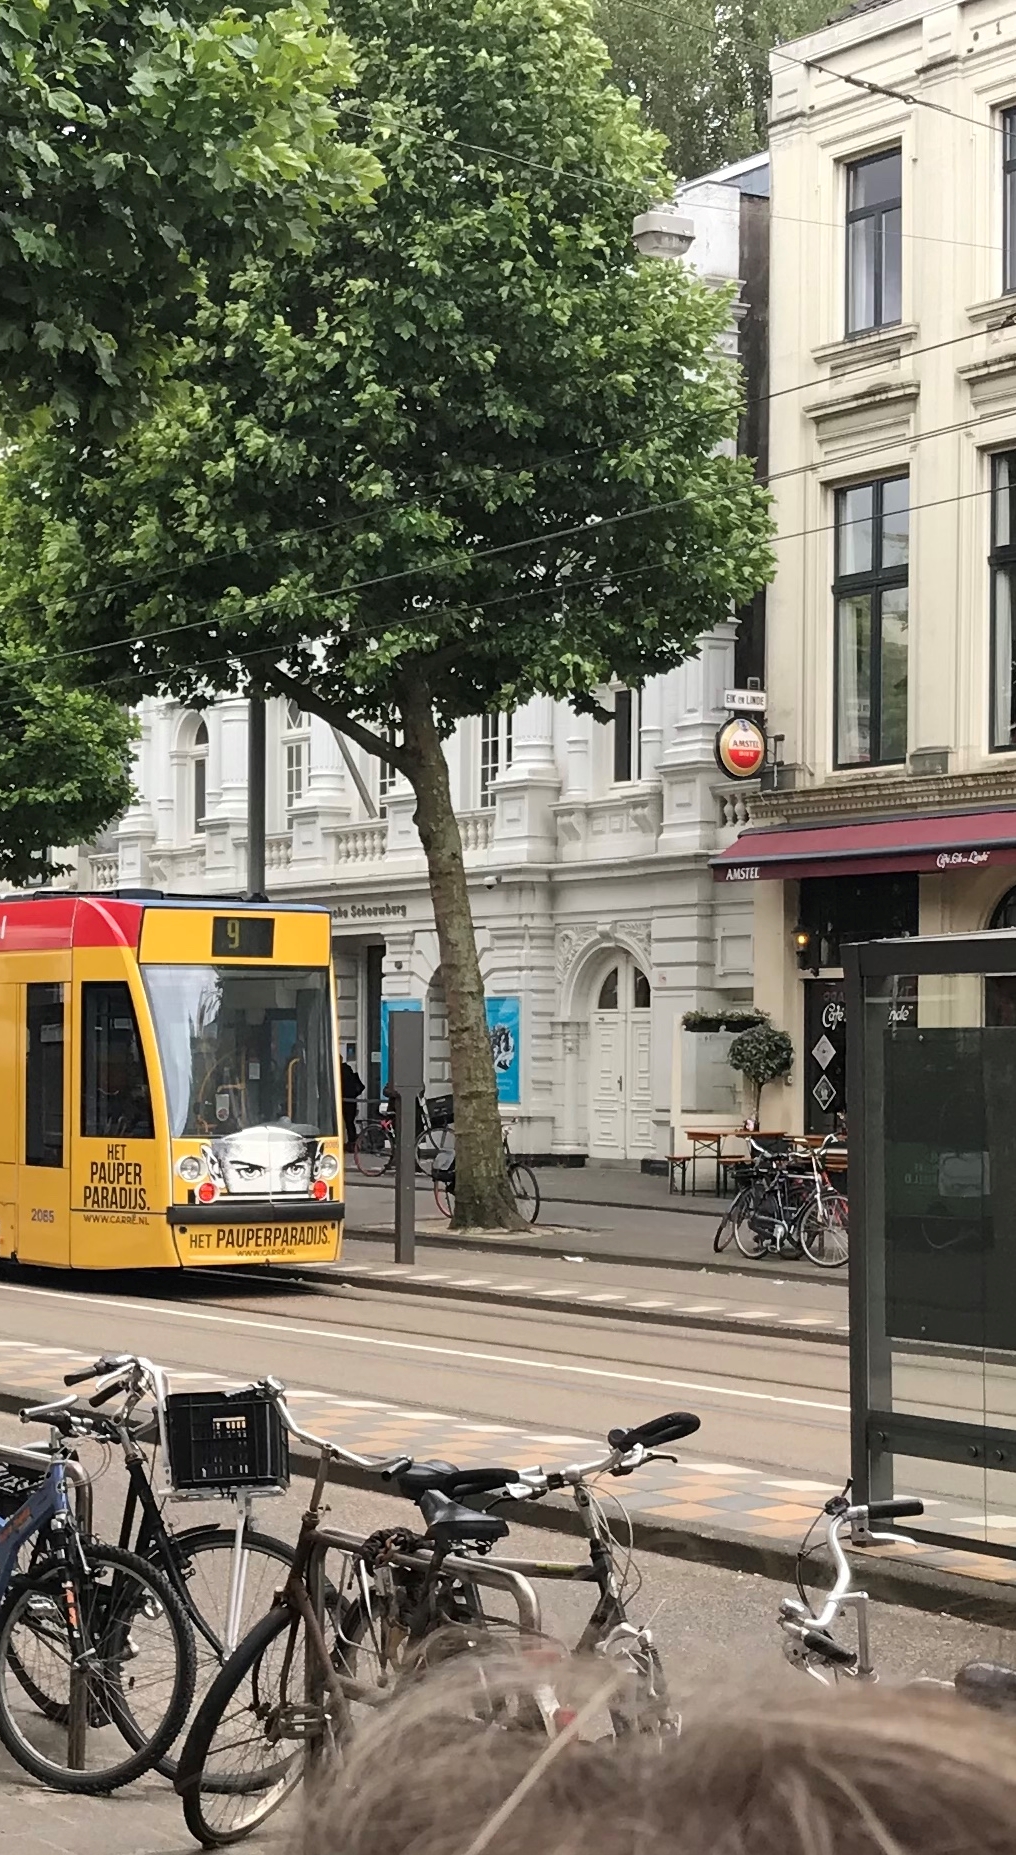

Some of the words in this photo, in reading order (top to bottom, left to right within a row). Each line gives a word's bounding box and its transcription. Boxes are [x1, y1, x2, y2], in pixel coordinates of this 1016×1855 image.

[732, 740, 760, 749] AMSTEL
[725, 867, 760, 881] AMSTEL
[350, 903, 407, 919] Schouwburg
[227, 919, 240, 950] 9
[107, 1143, 127, 1161] HET
[90, 1161, 143, 1186] PAUPER
[83, 1185, 151, 1212] PARADIJS.
[189, 1233, 213, 1249] HET
[216, 1224, 331, 1250] PAUPERPARADIJS.
